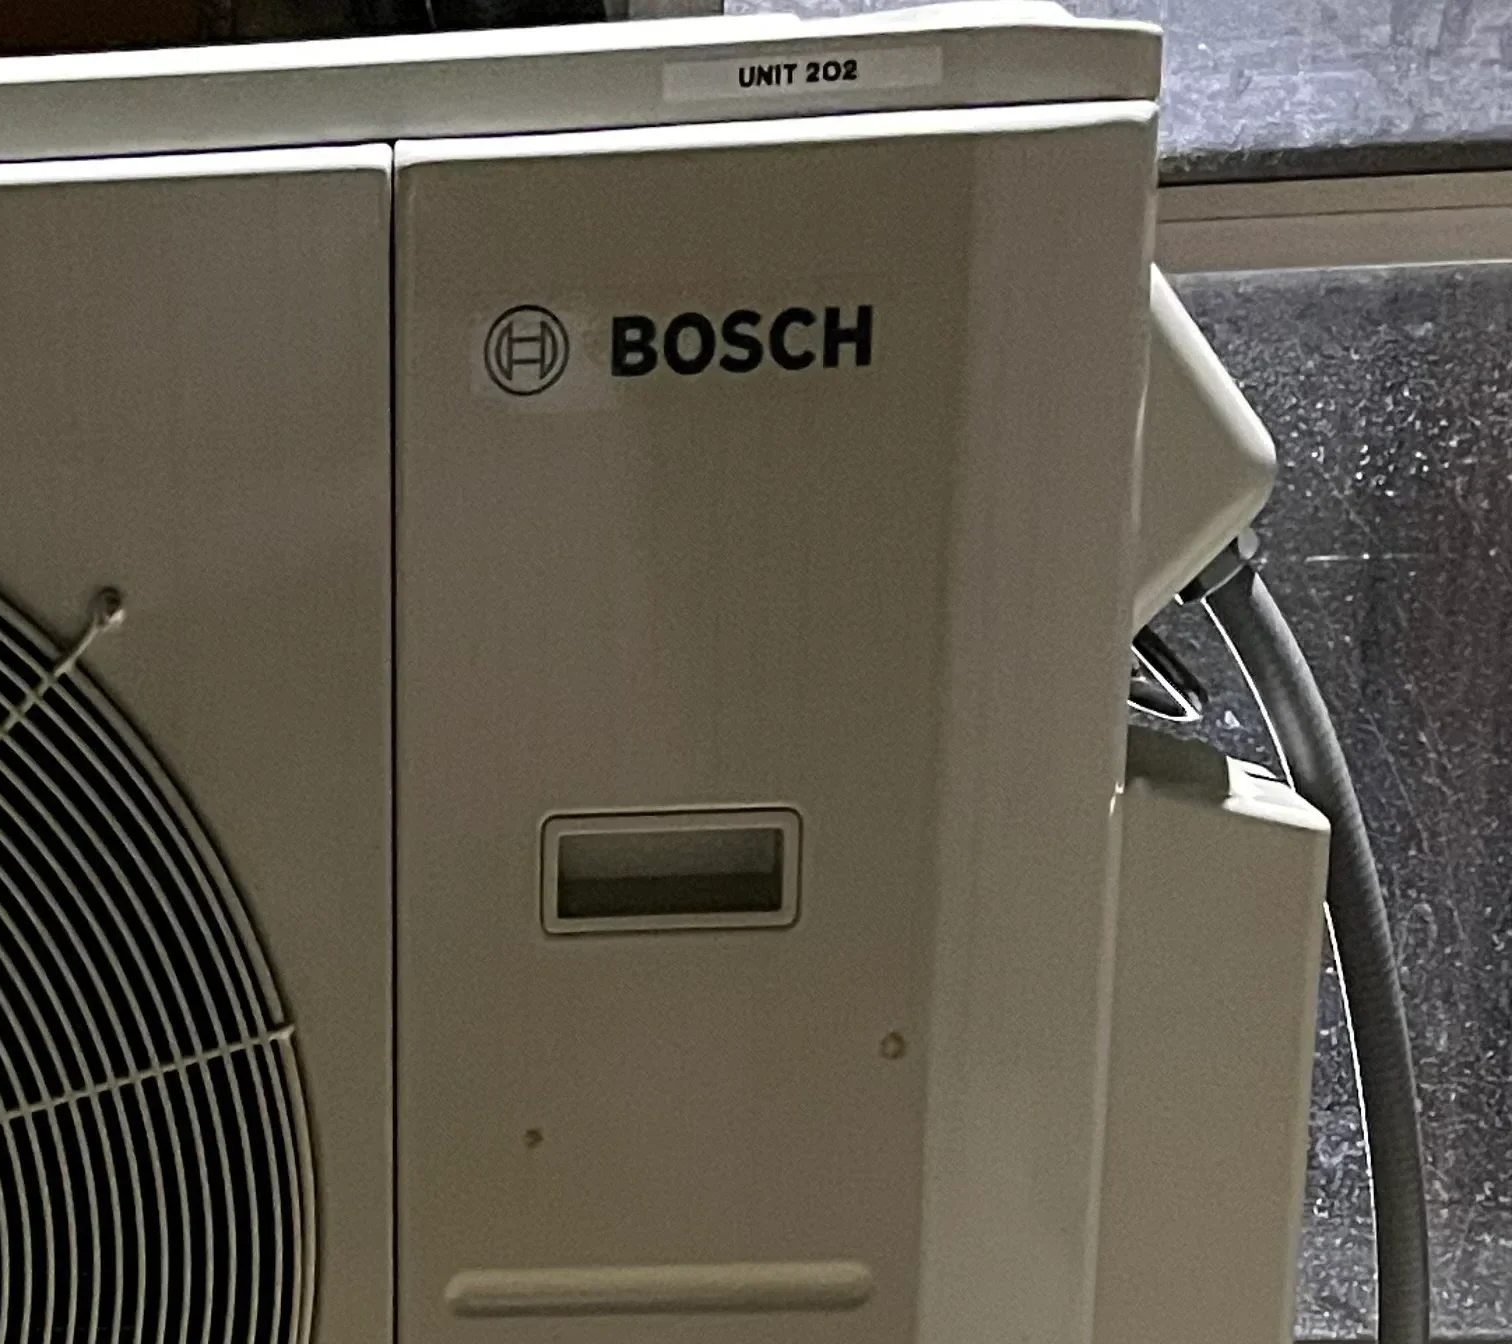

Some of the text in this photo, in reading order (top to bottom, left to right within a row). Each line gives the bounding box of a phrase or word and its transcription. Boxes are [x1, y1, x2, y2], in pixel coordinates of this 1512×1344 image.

[738, 59, 858, 87] UNIT 202
[611, 304, 872, 376] BOSCH
